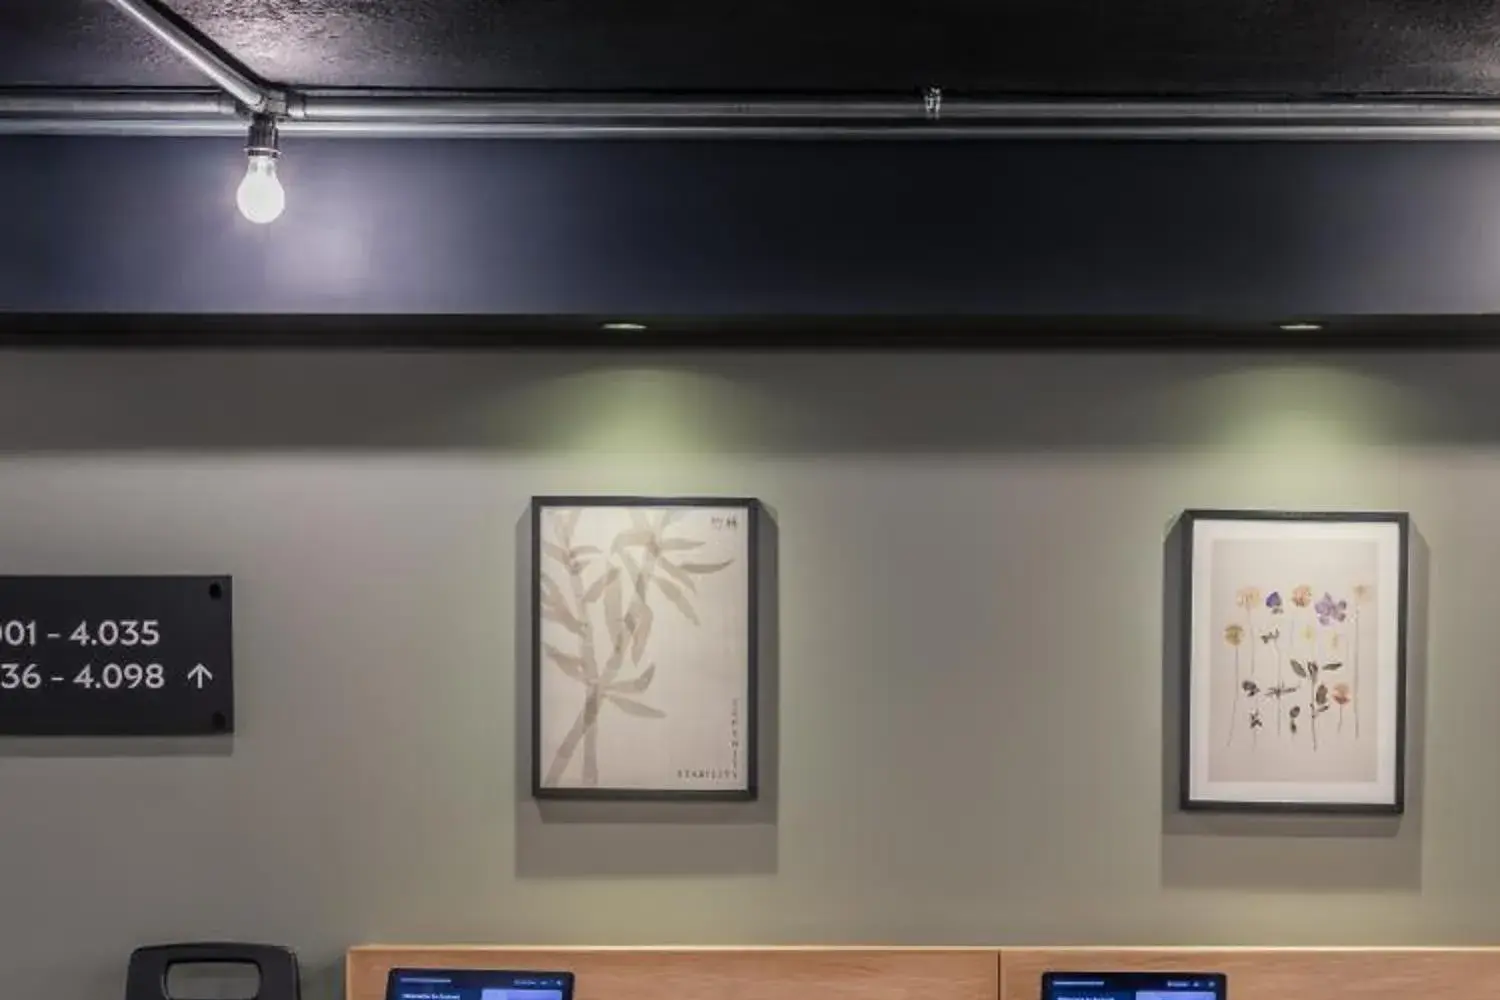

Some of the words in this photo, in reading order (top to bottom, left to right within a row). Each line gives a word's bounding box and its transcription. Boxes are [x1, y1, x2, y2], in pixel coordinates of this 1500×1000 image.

[0, 620, 36, 646] 01
[69, 620, 161, 646] 4.035
[1, 663, 41, 689] 36
[73, 663, 165, 689] 4.098
